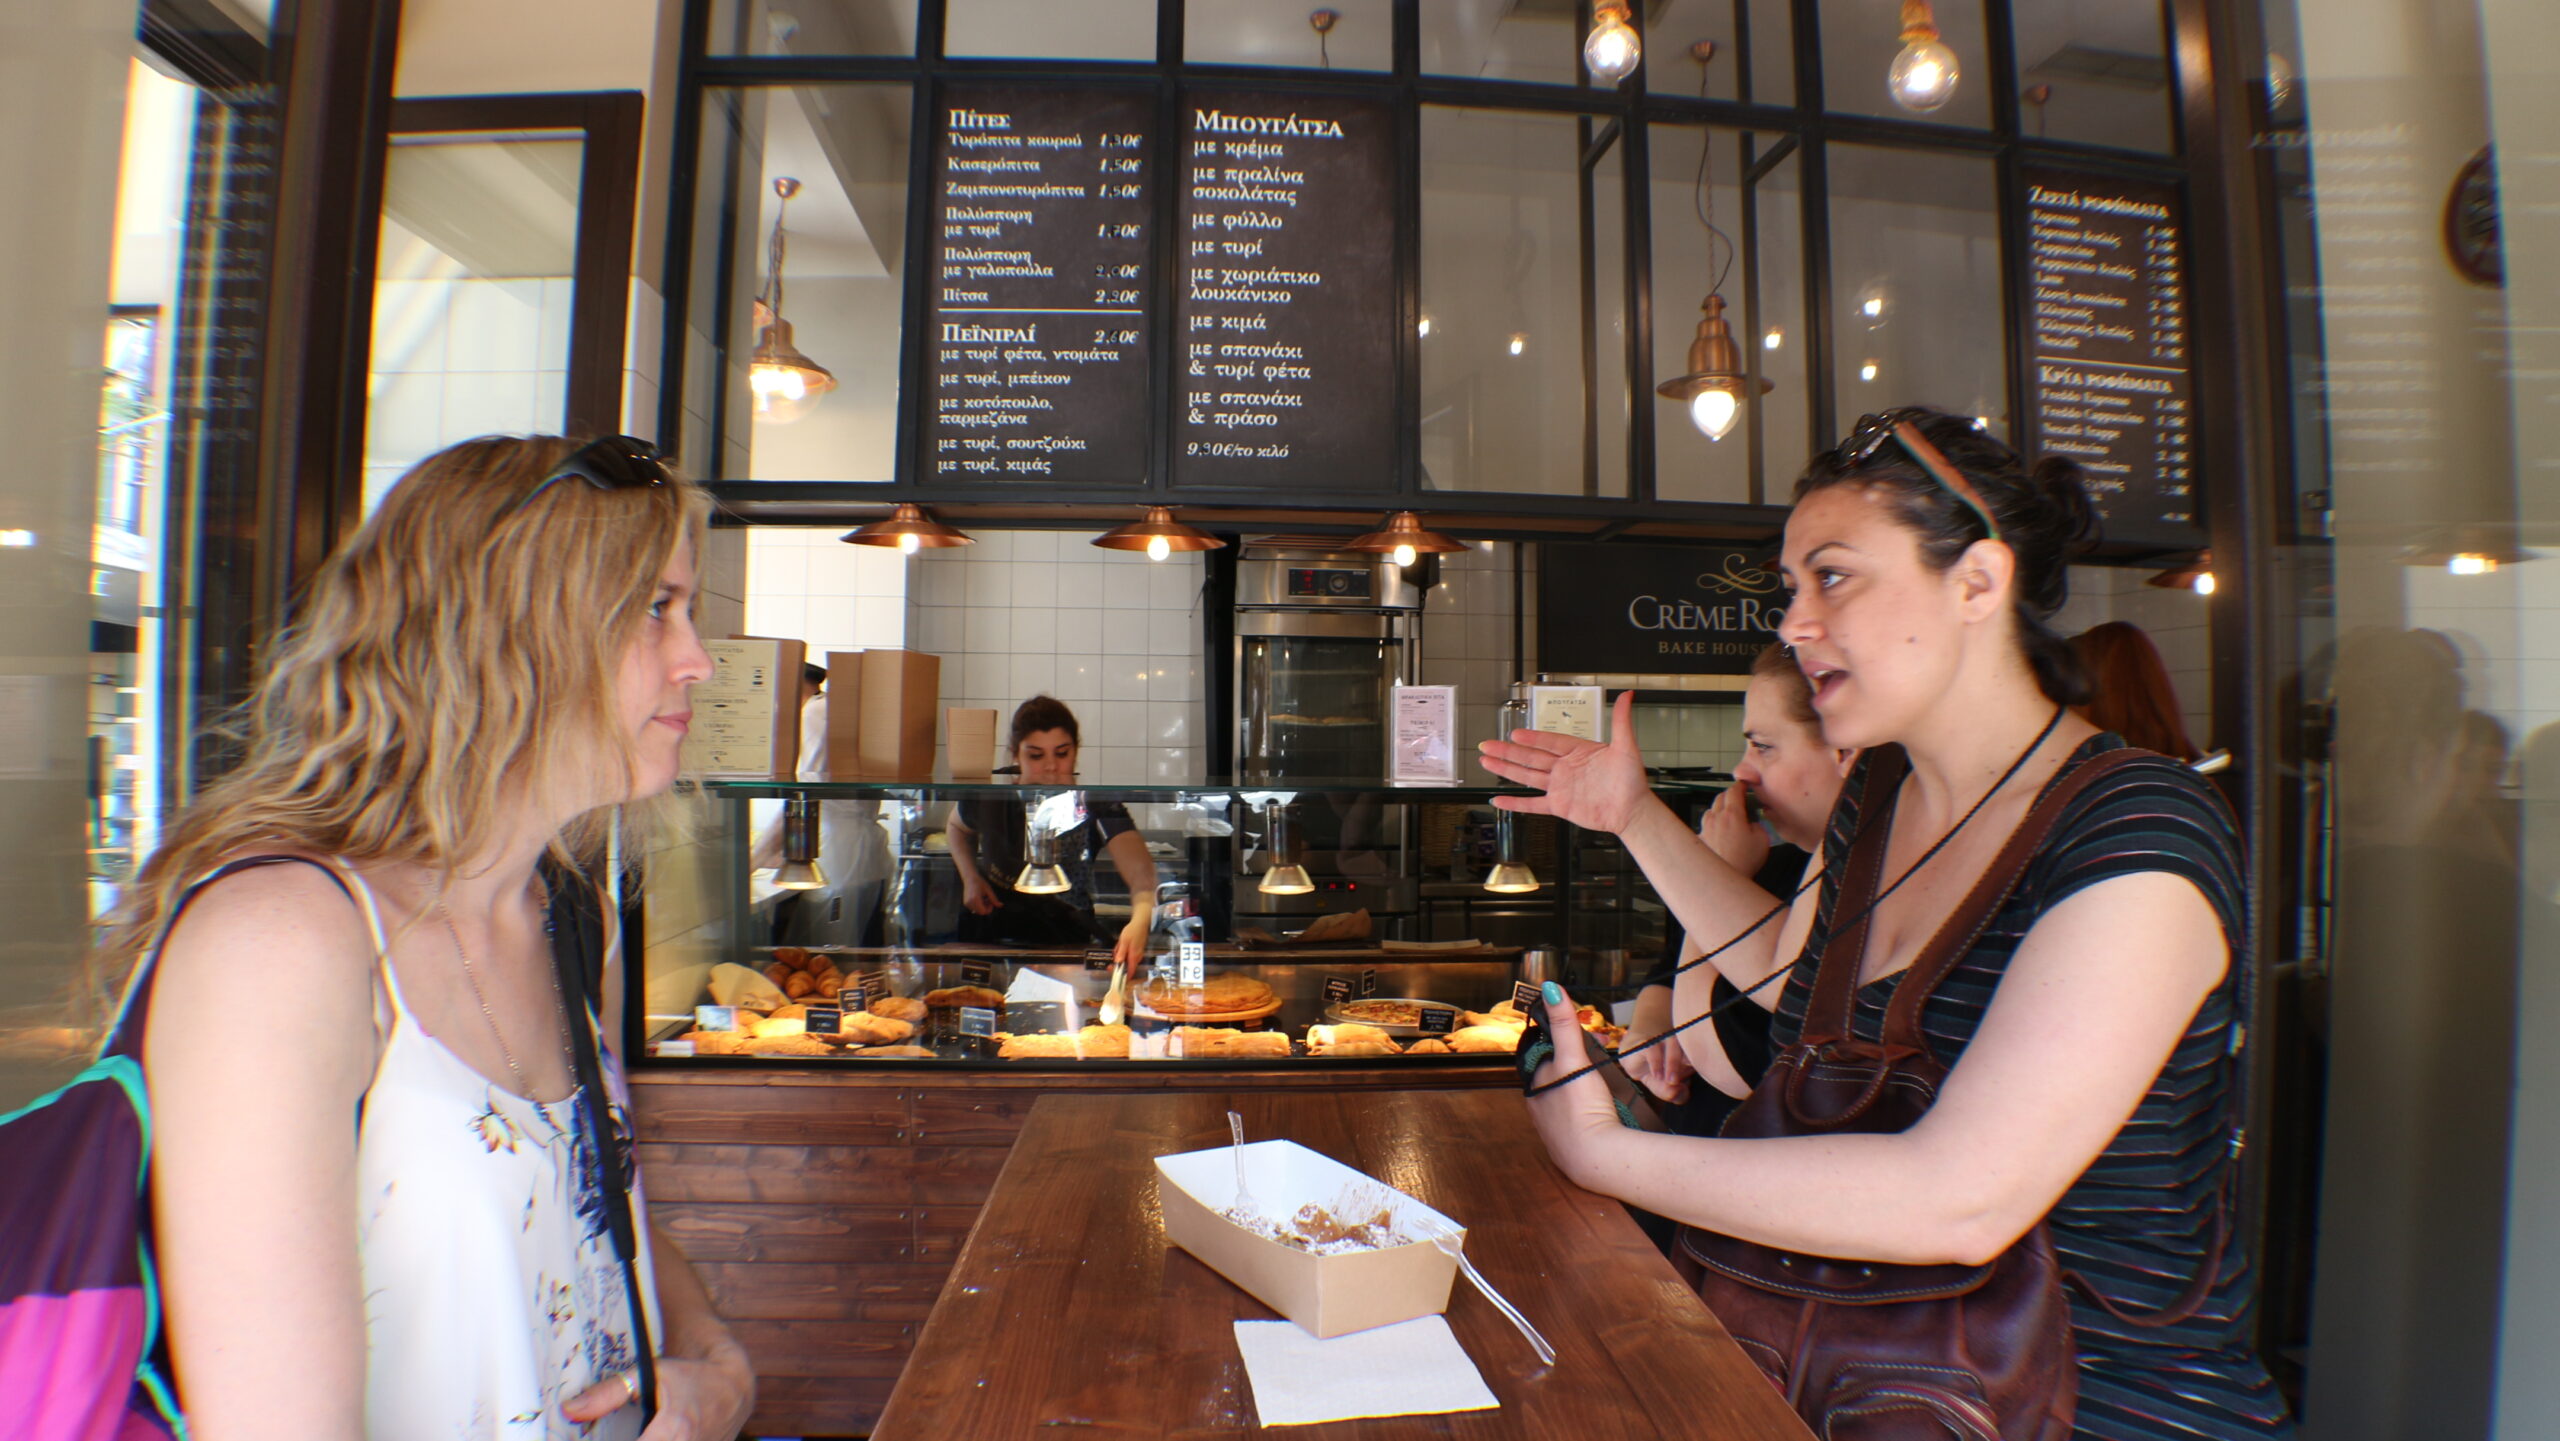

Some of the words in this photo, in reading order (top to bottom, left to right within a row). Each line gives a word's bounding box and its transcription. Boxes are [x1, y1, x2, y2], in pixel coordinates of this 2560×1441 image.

[948, 132, 1021, 149] Τυρόπιτα
[1194, 140, 1216, 157] με
[1224, 139, 1283, 159] κρέμα
[947, 156, 1040, 174] Κασερόπιτα
[1193, 167, 1216, 183] με
[1224, 166, 1304, 185] πραλίνα
[946, 181, 1085, 199] Ζαμπονοτυρόπιτα
[1192, 184, 1296, 207] σοκολάτας
[946, 206, 1033, 225] Πολύσπορη
[1192, 212, 1215, 230] με
[1223, 211, 1283, 231] φύλλο
[944, 225, 963, 239] με
[968, 222, 1001, 239] τυρί
[944, 246, 1031, 265] Πολύσπορη
[1191, 239, 1215, 256] με
[1222, 238, 1263, 259] τυρί
[943, 265, 961, 279] με
[1191, 266, 1214, 283] με
[1221, 266, 1321, 285] χωριάτικο
[943, 288, 989, 303] Πίτσα
[1190, 283, 1291, 303] λουκάνικο
[1190, 315, 1213, 332] με
[1221, 313, 1266, 333] κιμά
[941, 348, 960, 363] με
[965, 346, 998, 363] τυρί
[1004, 346, 1046, 363] φέτα,
[1052, 346, 1119, 364] ντομάτα
[1189, 342, 1212, 359] με
[1220, 341, 1303, 359] σπανάκι
[940, 373, 959, 387] με
[964, 370, 1002, 387] τυρί,
[1008, 371, 1071, 387] μπέικον
[1189, 360, 1205, 376] &
[1214, 360, 1255, 381] τυρί
[1263, 362, 1311, 382] φέτα
[939, 397, 958, 411] με
[964, 395, 1053, 411] κοτόπουλο,
[1188, 391, 1212, 408] με
[1220, 389, 1303, 407] σπανάκι
[939, 410, 1028, 428] παρμεζάνα
[1188, 408, 1205, 424] &
[1214, 409, 1278, 429] πράσο
[938, 437, 957, 452] με
[963, 435, 1001, 452] τυρί,
[1006, 435, 1086, 452] σουτζούκι
[1257, 444, 1289, 458] κιλό
[937, 459, 957, 473] με
[962, 457, 1000, 473] τυρί,
[1006, 457, 1051, 474] κιμάς
[1659, 641, 1706, 655] BAKE
